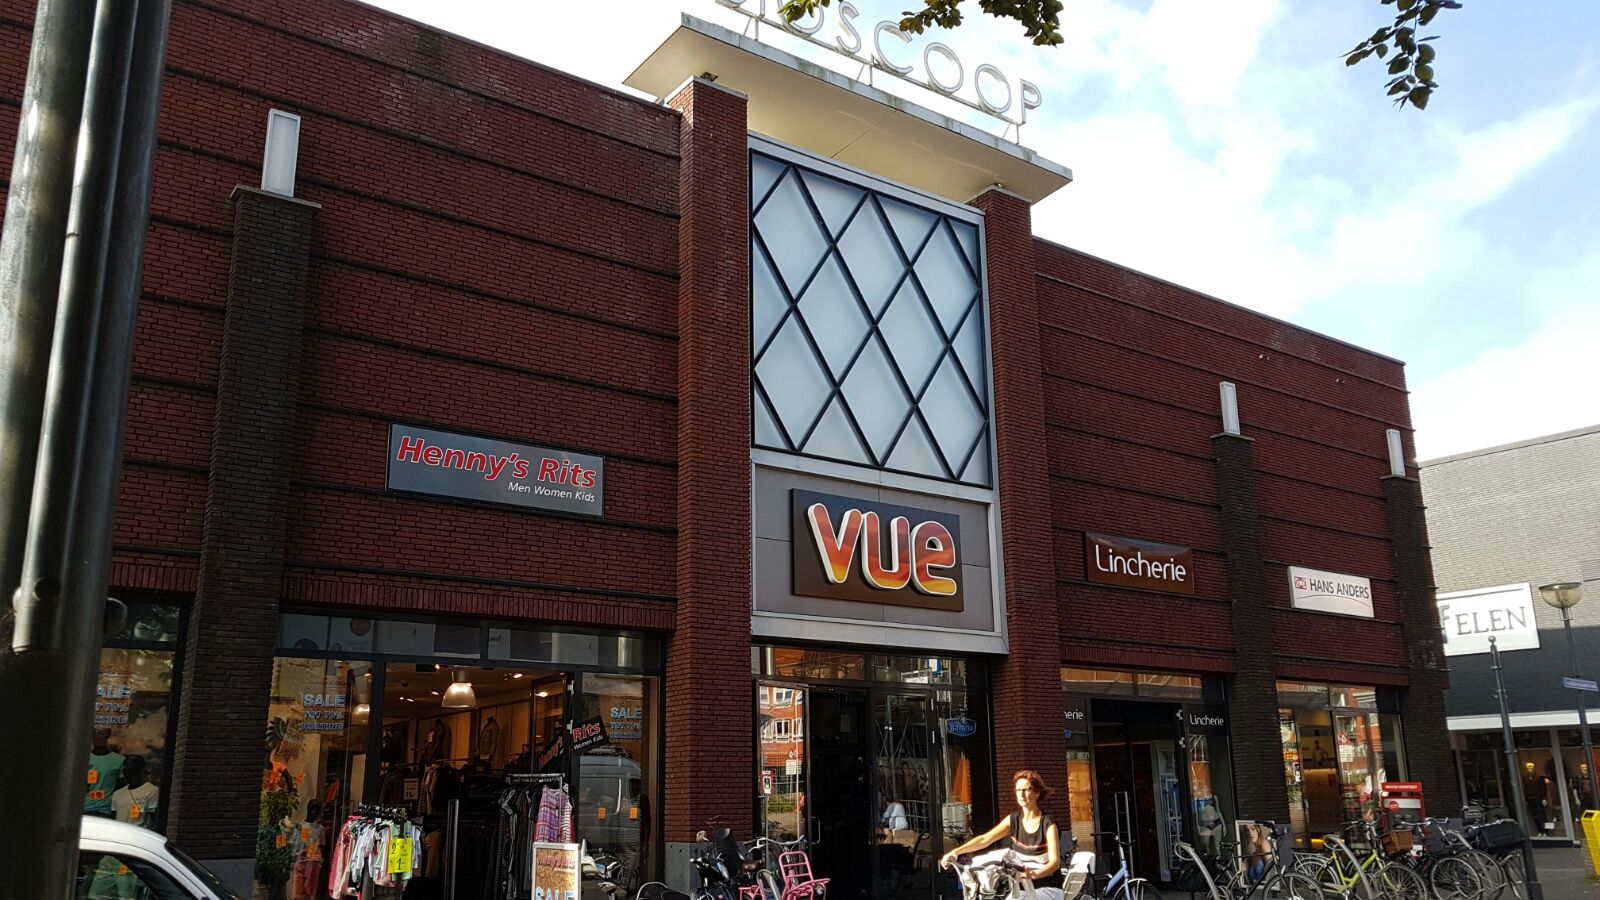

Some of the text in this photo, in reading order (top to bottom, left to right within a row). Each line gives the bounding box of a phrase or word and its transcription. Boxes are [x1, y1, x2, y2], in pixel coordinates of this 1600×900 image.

[396, 435, 597, 488] Henny's Rits
[507, 481, 595, 502] Men Women Kids
[1095, 544, 1187, 582] Lincherie
[1309, 578, 1370, 599] HANS ANDERS
[304, 694, 345, 707] SALE
[611, 707, 641, 719] SALE
[1190, 713, 1224, 726] Lincherie
[572, 722, 601, 742] Rits
